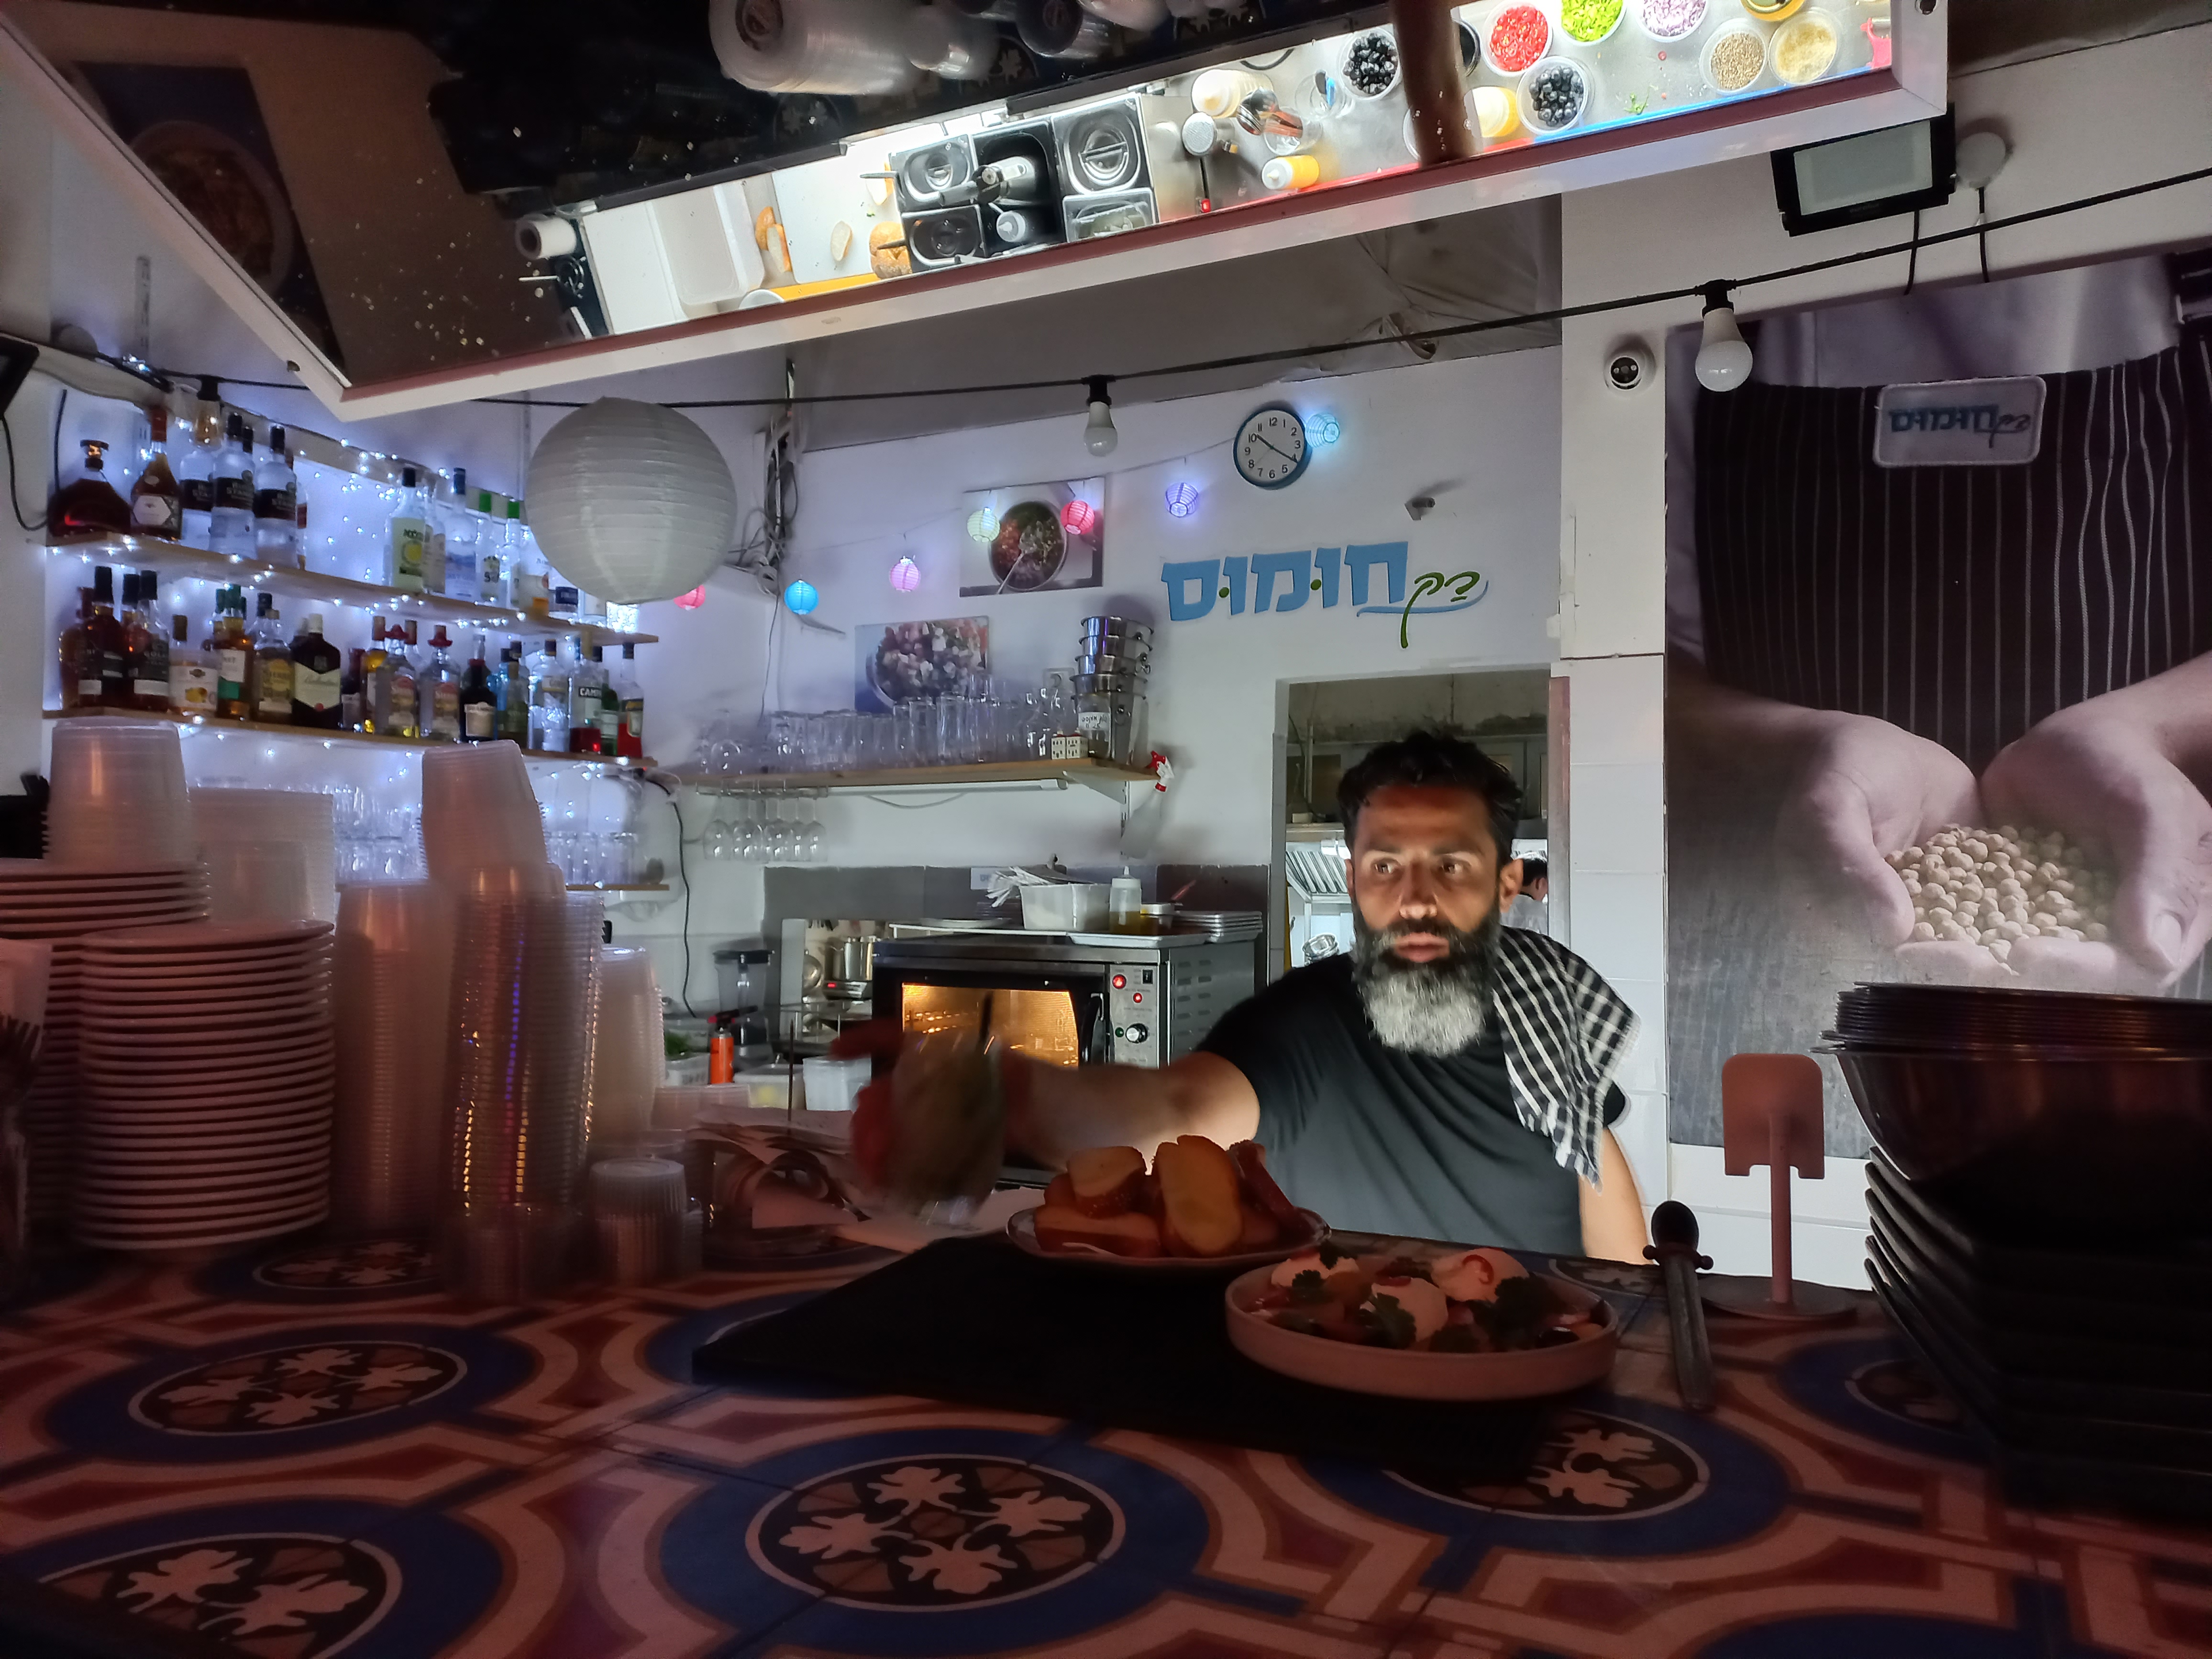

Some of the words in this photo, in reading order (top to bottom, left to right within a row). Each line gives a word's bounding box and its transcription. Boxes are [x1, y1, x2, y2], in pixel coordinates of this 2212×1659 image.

[1269, 417, 1277, 427] 12
[1258, 423, 1262, 431] 11
[1291, 427, 1297, 436] 2
[1248, 433, 1257, 442] 10
[1294, 440, 1301, 449] 3
[1245, 447, 1250, 455] 9
[1248, 459, 1254, 468] 8
[1258, 468, 1263, 477] 7
[1282, 465, 1288, 473] 5
[1269, 470, 1275, 478] 6
